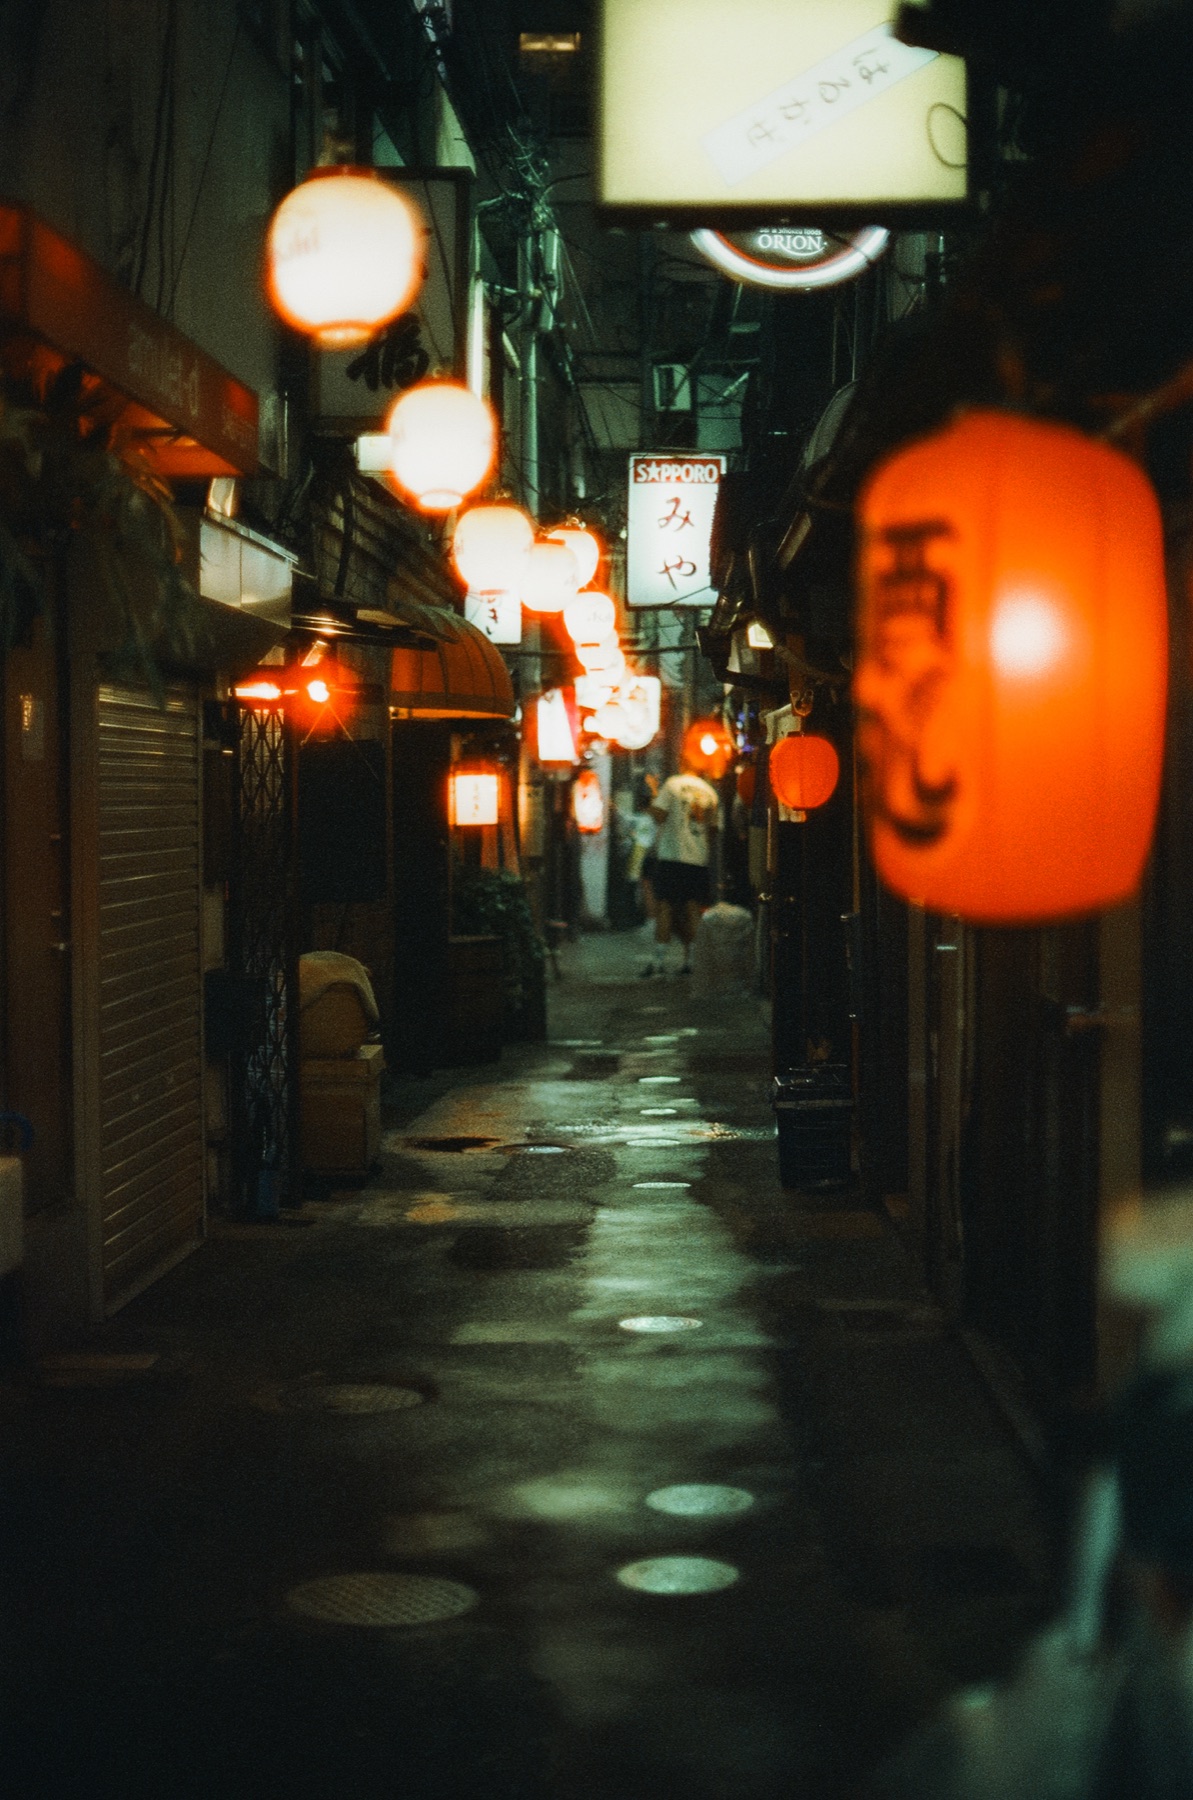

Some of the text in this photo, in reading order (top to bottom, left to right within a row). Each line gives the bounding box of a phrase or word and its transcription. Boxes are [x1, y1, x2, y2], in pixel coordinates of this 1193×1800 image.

[758, 234, 823, 252] ORION
[636, 461, 718, 483] SAPPORO
[657, 496, 697, 591] みや
